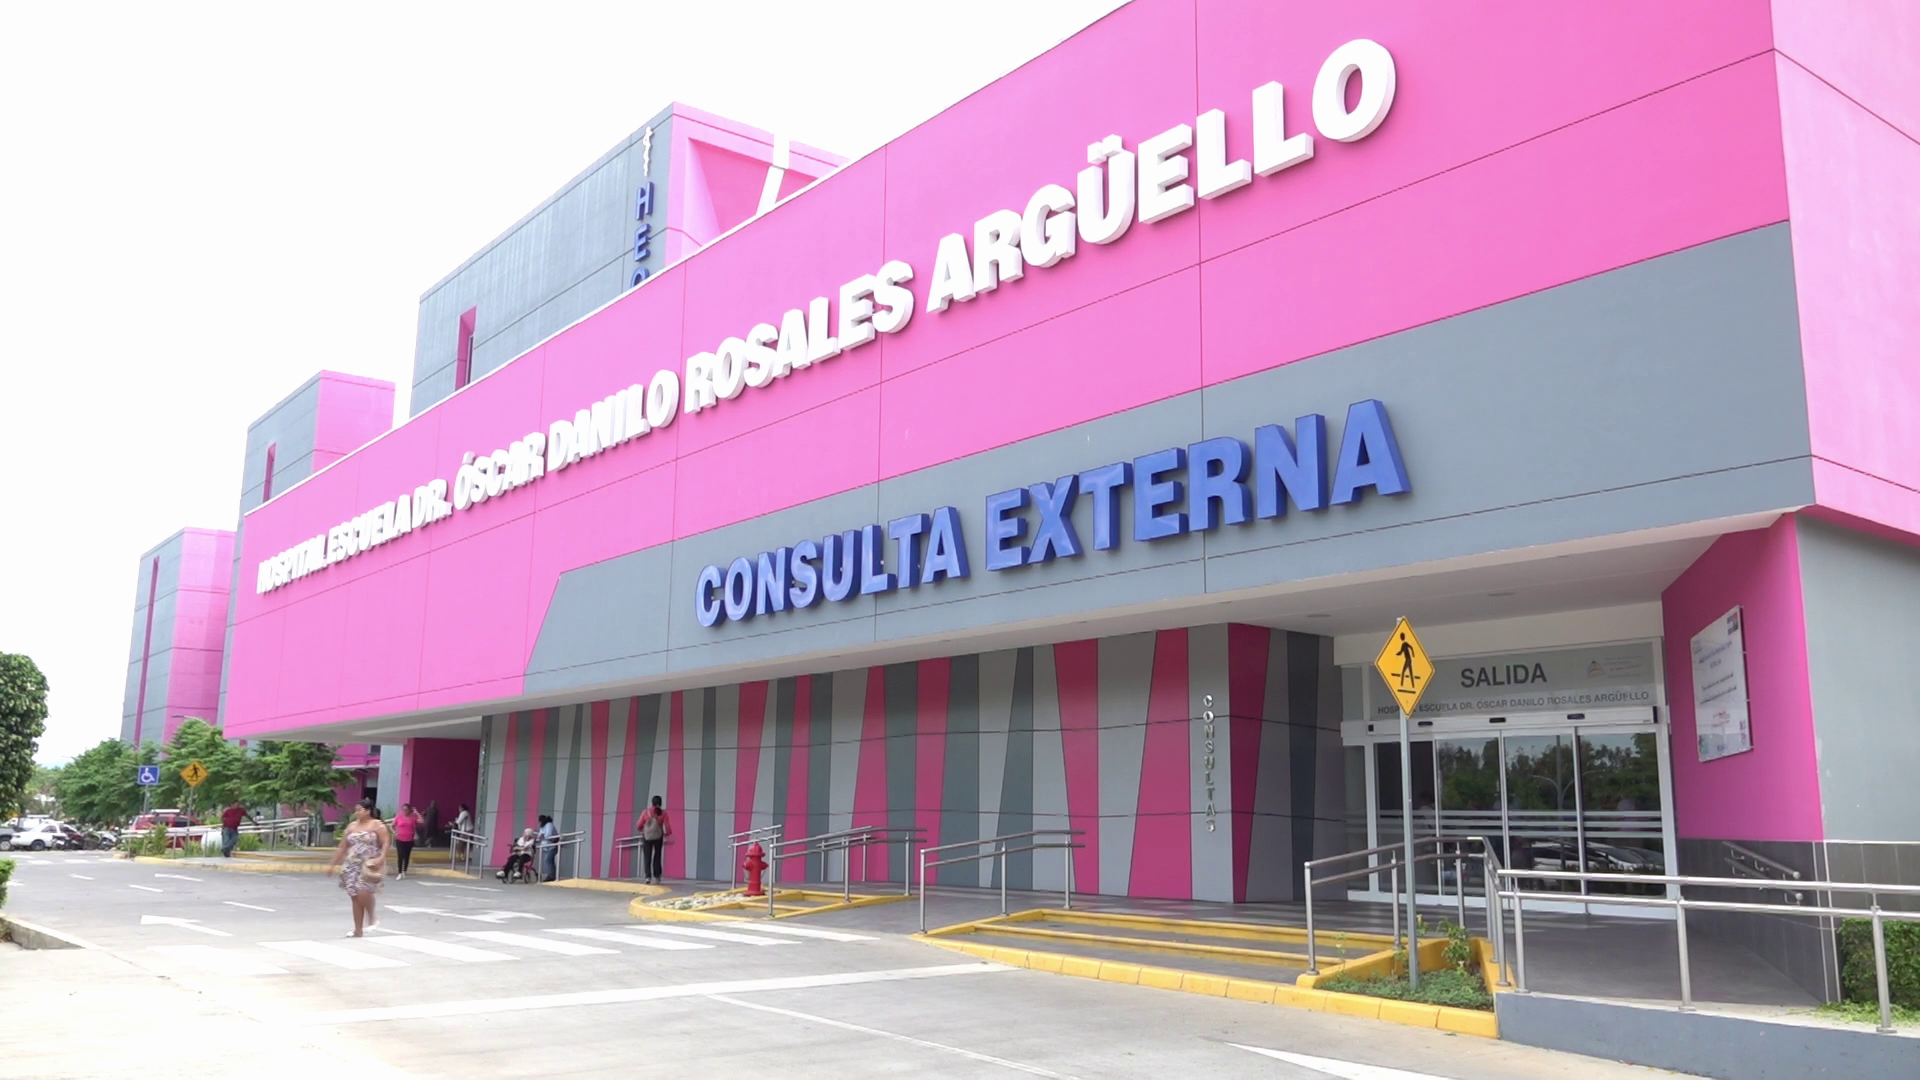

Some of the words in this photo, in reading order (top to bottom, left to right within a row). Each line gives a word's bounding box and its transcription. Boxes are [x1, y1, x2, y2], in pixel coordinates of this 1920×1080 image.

[256, 534, 329, 594] HOSPITAL
[326, 494, 412, 565] ESCUELA
[412, 479, 453, 528] DR.
[453, 431, 547, 510] ÓSCAR
[547, 369, 680, 472] DANILO
[684, 260, 915, 415] ROSALES
[926, 38, 1397, 314] ARGÜELLO
[695, 506, 970, 627] CONSULTA
[985, 399, 1411, 572] EXTERNA
[1377, 705, 1417, 715] HOSP
[1418, 702, 1458, 713] ESCUELA
[1510, 697, 1545, 708] DANILO
[1547, 694, 1592, 706] ROSALES
[1594, 690, 1650, 703] ARGÜELLO
[1460, 663, 1548, 688] SALIDA
[1202, 694, 1216, 833] CONSULTAS
